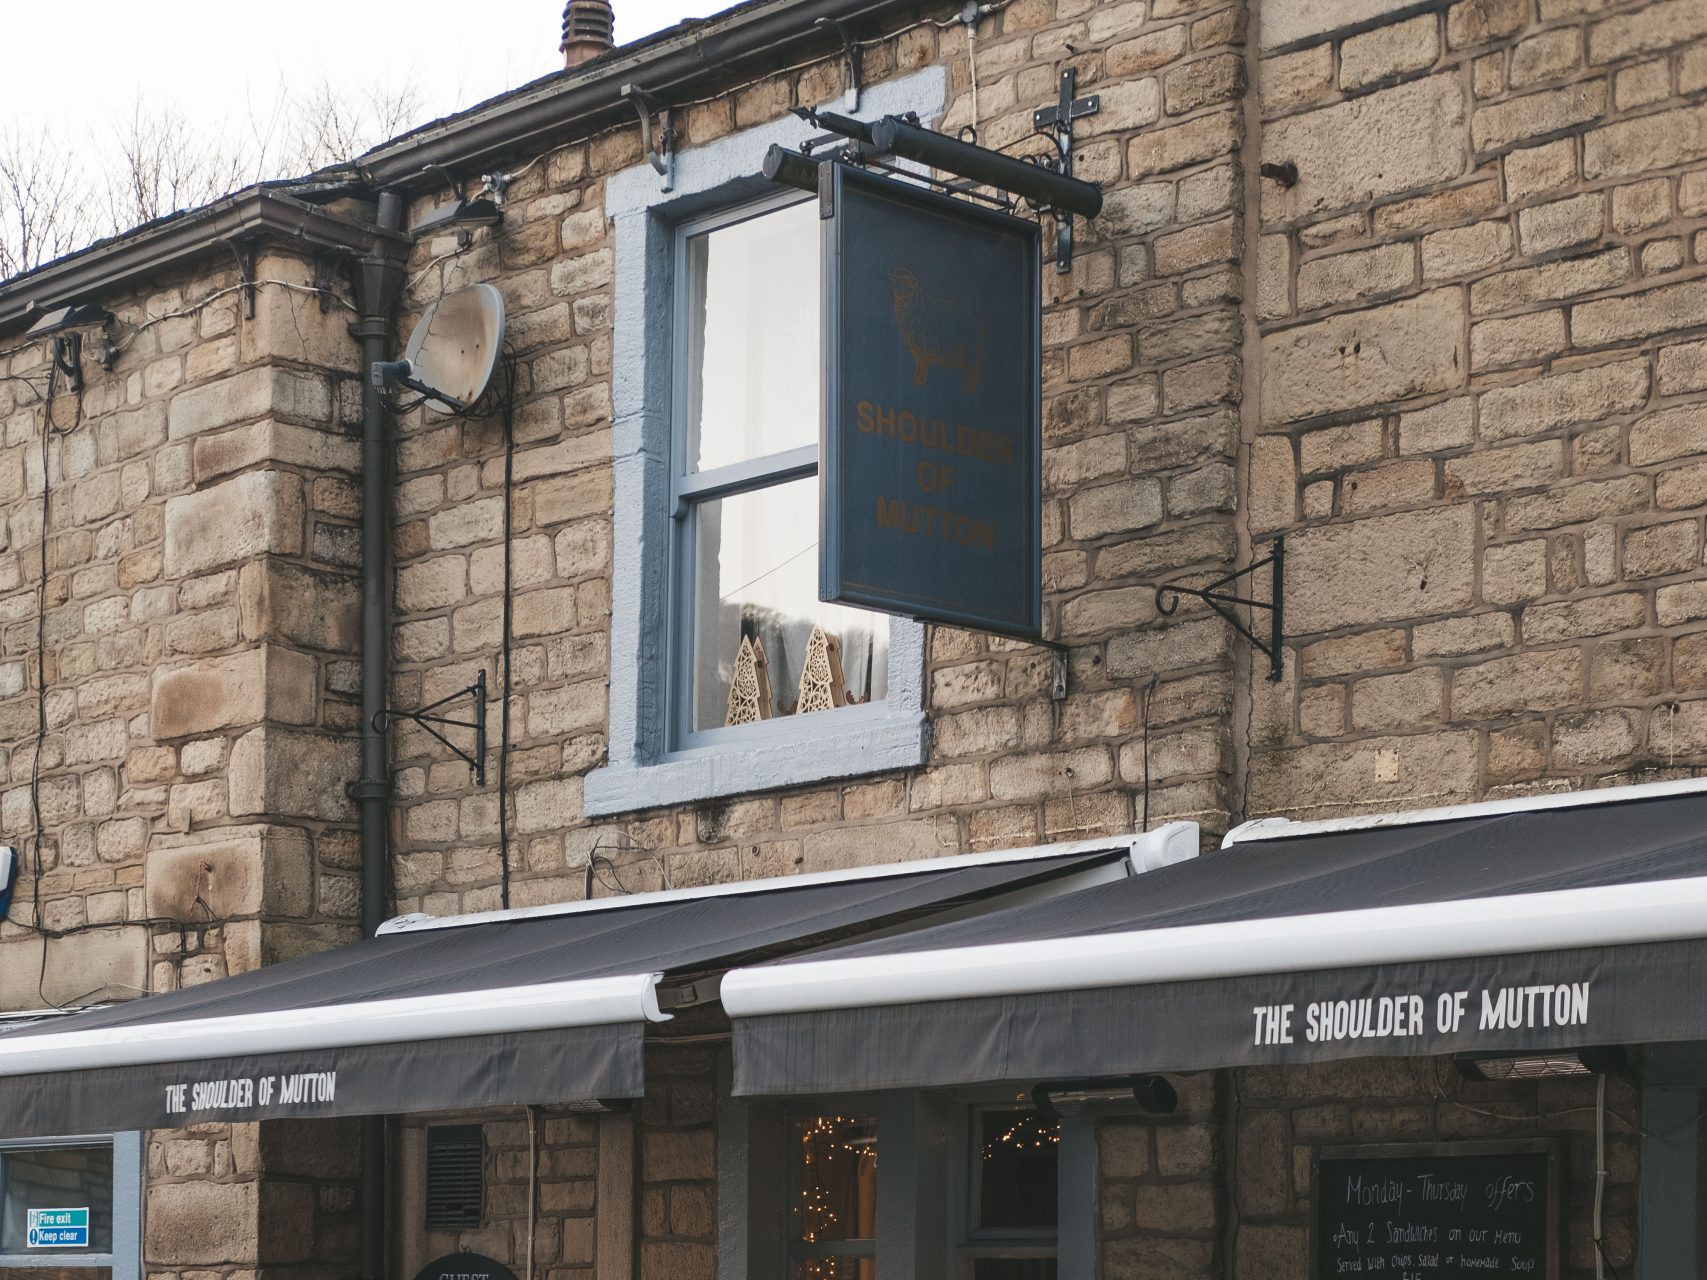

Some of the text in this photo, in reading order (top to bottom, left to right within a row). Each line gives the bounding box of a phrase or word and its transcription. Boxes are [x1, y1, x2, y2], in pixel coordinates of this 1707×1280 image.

[856, 399, 1014, 465] SHOULDER
[916, 461, 957, 496] OF
[876, 496, 994, 551] MUTTON
[1253, 982, 1589, 1045] THE SHOULDER OF MUTTON
[165, 1071, 336, 1114] THE SHOULDER OF MUTTON
[1347, 1175, 1403, 1216] Monday
[1417, 1173, 1467, 1211] Thursday
[40, 1212, 71, 1224] Fire exit
[40, 1230, 78, 1243] Keep clear
[1338, 1221, 1359, 1254] Any
[1366, 1222, 1375, 1244] 2
[1448, 1228, 1462, 1241] on
